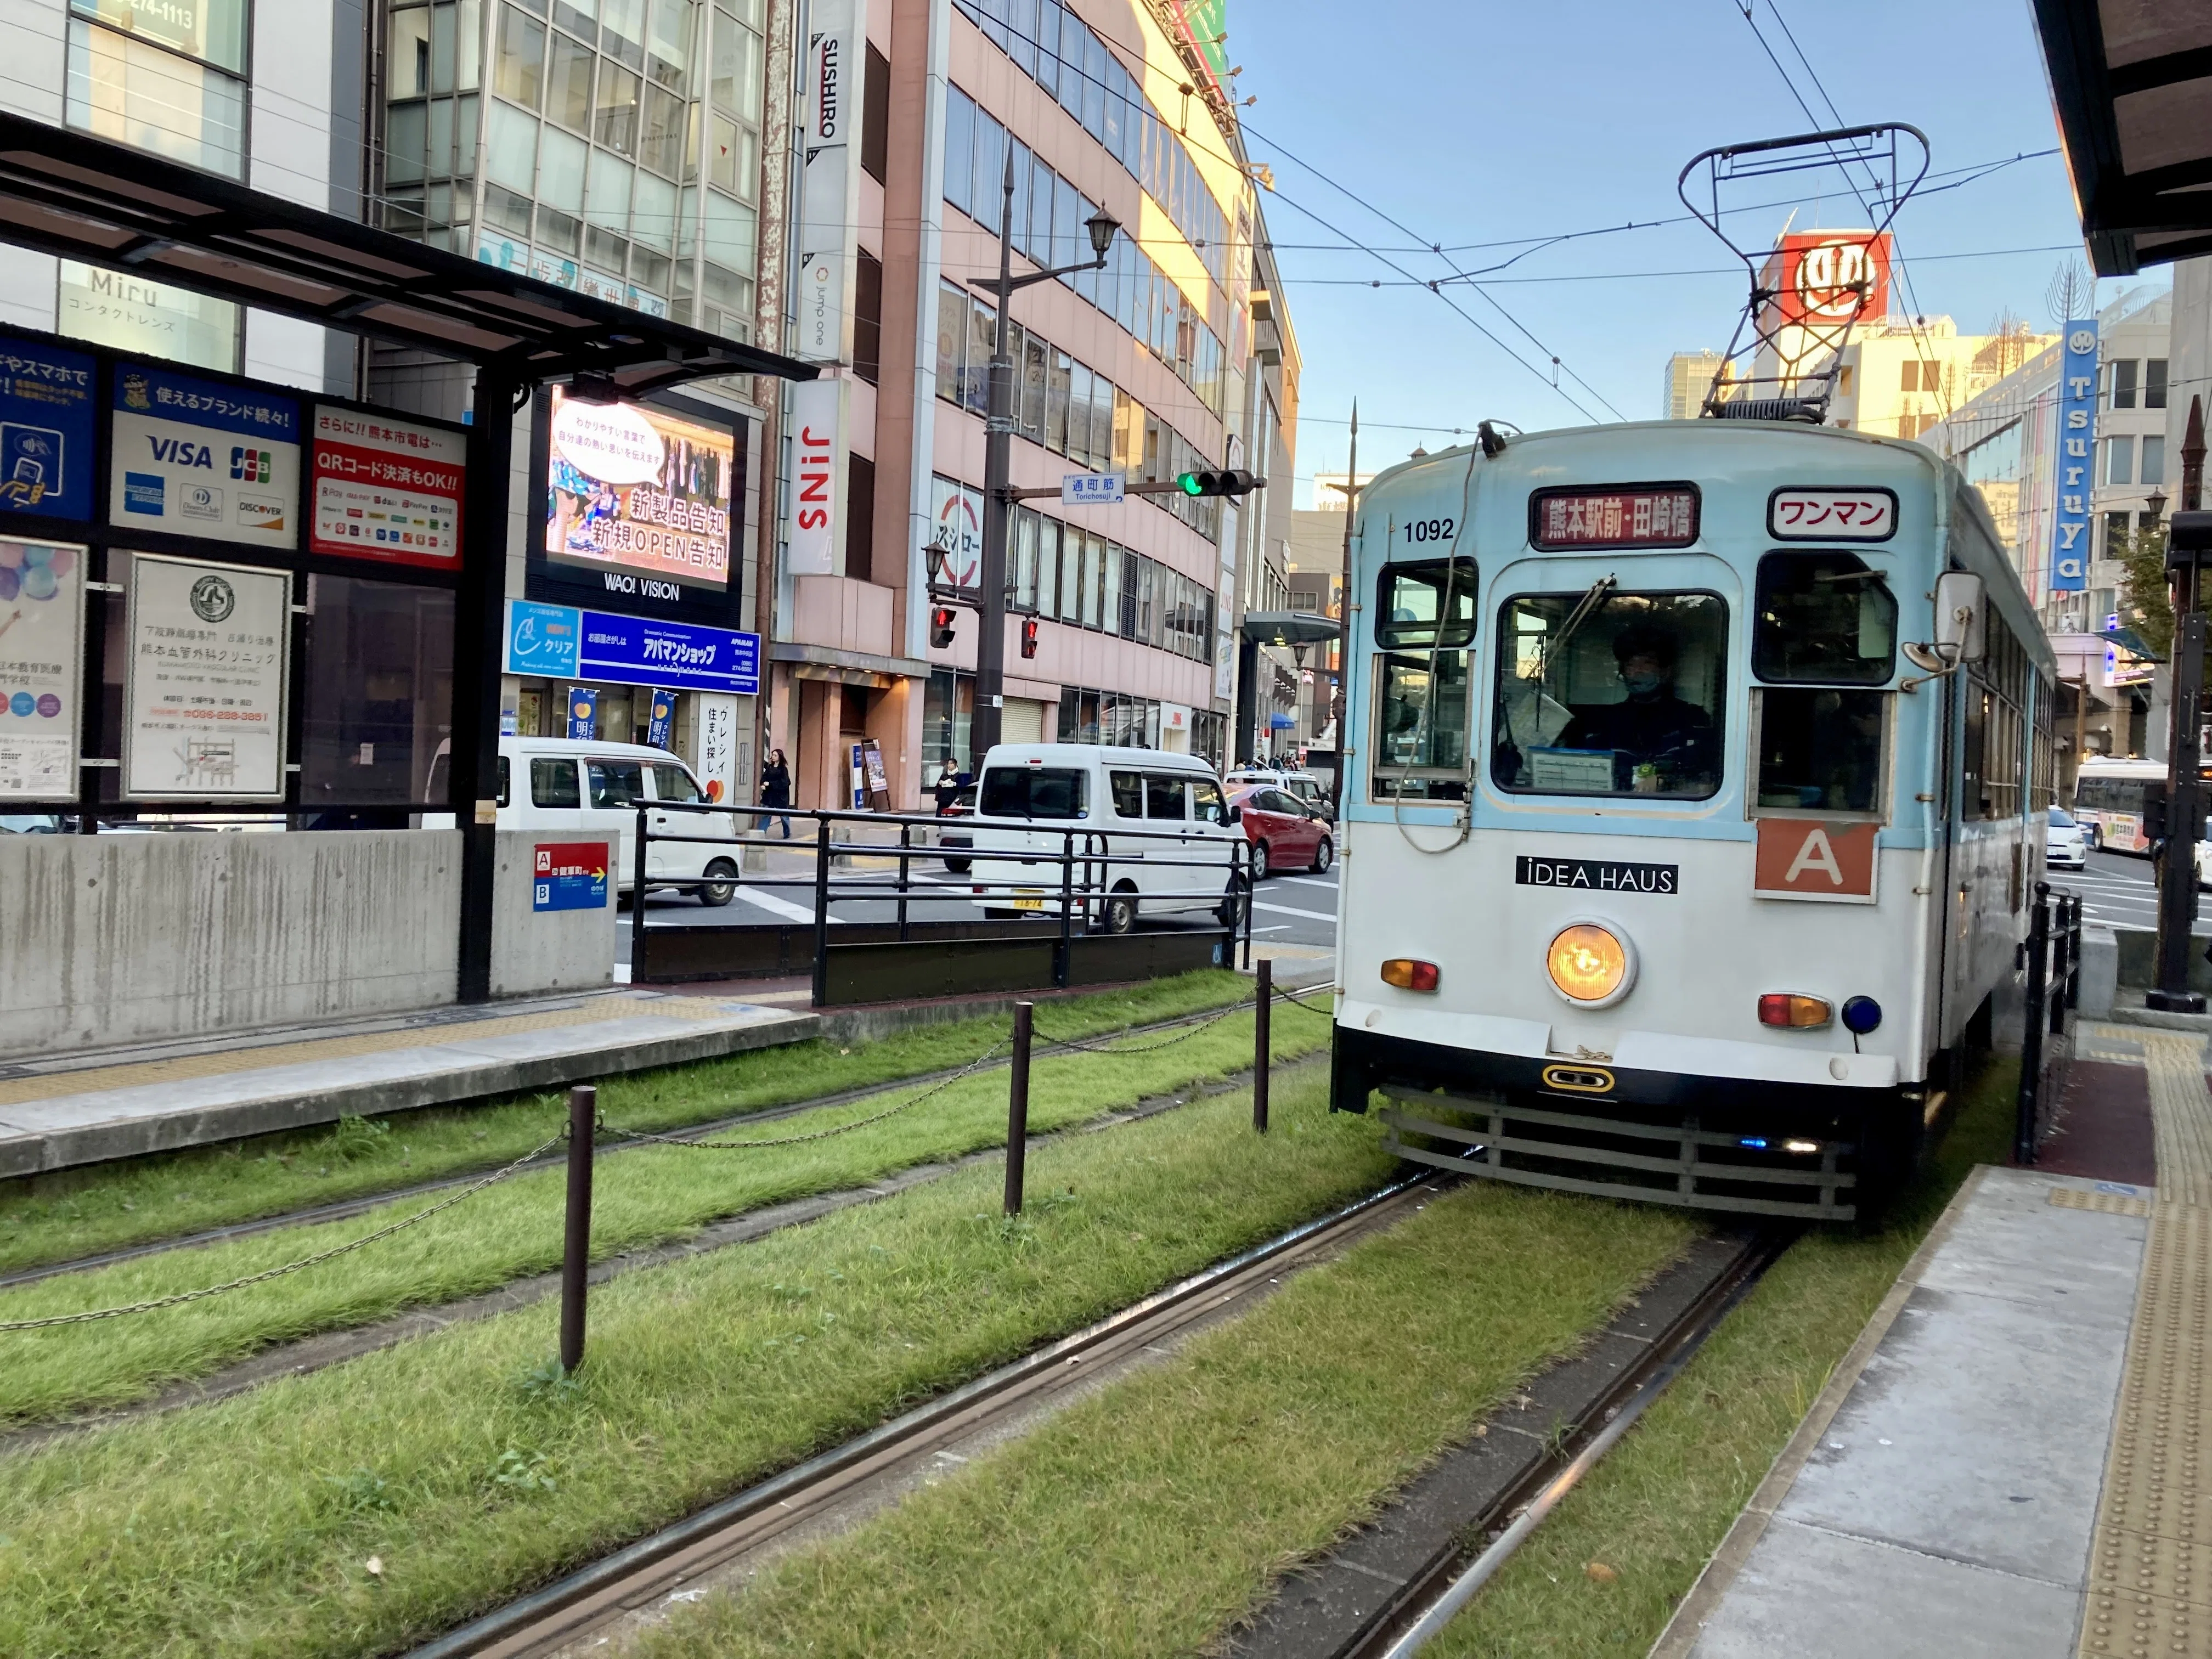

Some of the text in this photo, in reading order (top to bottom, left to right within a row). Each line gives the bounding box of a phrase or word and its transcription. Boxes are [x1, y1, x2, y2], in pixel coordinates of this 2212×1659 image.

[822, 39, 838, 138] SUSHIRO
[90, 269, 157, 308] Miru
[815, 286, 827, 317] jump
[69, 297, 176, 333] コンタクトレンズ
[577, 417, 646, 444] わかりやすい言葉で
[144, 435, 213, 470] VISA
[558, 430, 660, 465] 自分達の熱い思いを伝えます
[1073, 478, 1114, 492] 通町筋
[2058, 376, 2091, 579] Tsuruya
[239, 501, 282, 515] DISCOVER
[630, 488, 725, 535] 新製品告知
[1780, 501, 1885, 526] ワンマン
[591, 517, 723, 569] 新規OPEN告知
[936, 525, 980, 552] スシロー
[1403, 518, 1454, 543] 1092
[604, 573, 679, 601] WAO! VISION
[544, 639, 573, 655] クリア
[588, 633, 627, 646] お部屋さがしは
[643, 638, 716, 665] アパマンショップ
[731, 638, 753, 647] APAMAN
[707, 708, 717, 772] 住まい探し
[539, 854, 548, 866] A
[1785, 828, 1844, 886] A
[539, 887, 546, 899] B
[1600, 867, 1673, 894] HAUS
